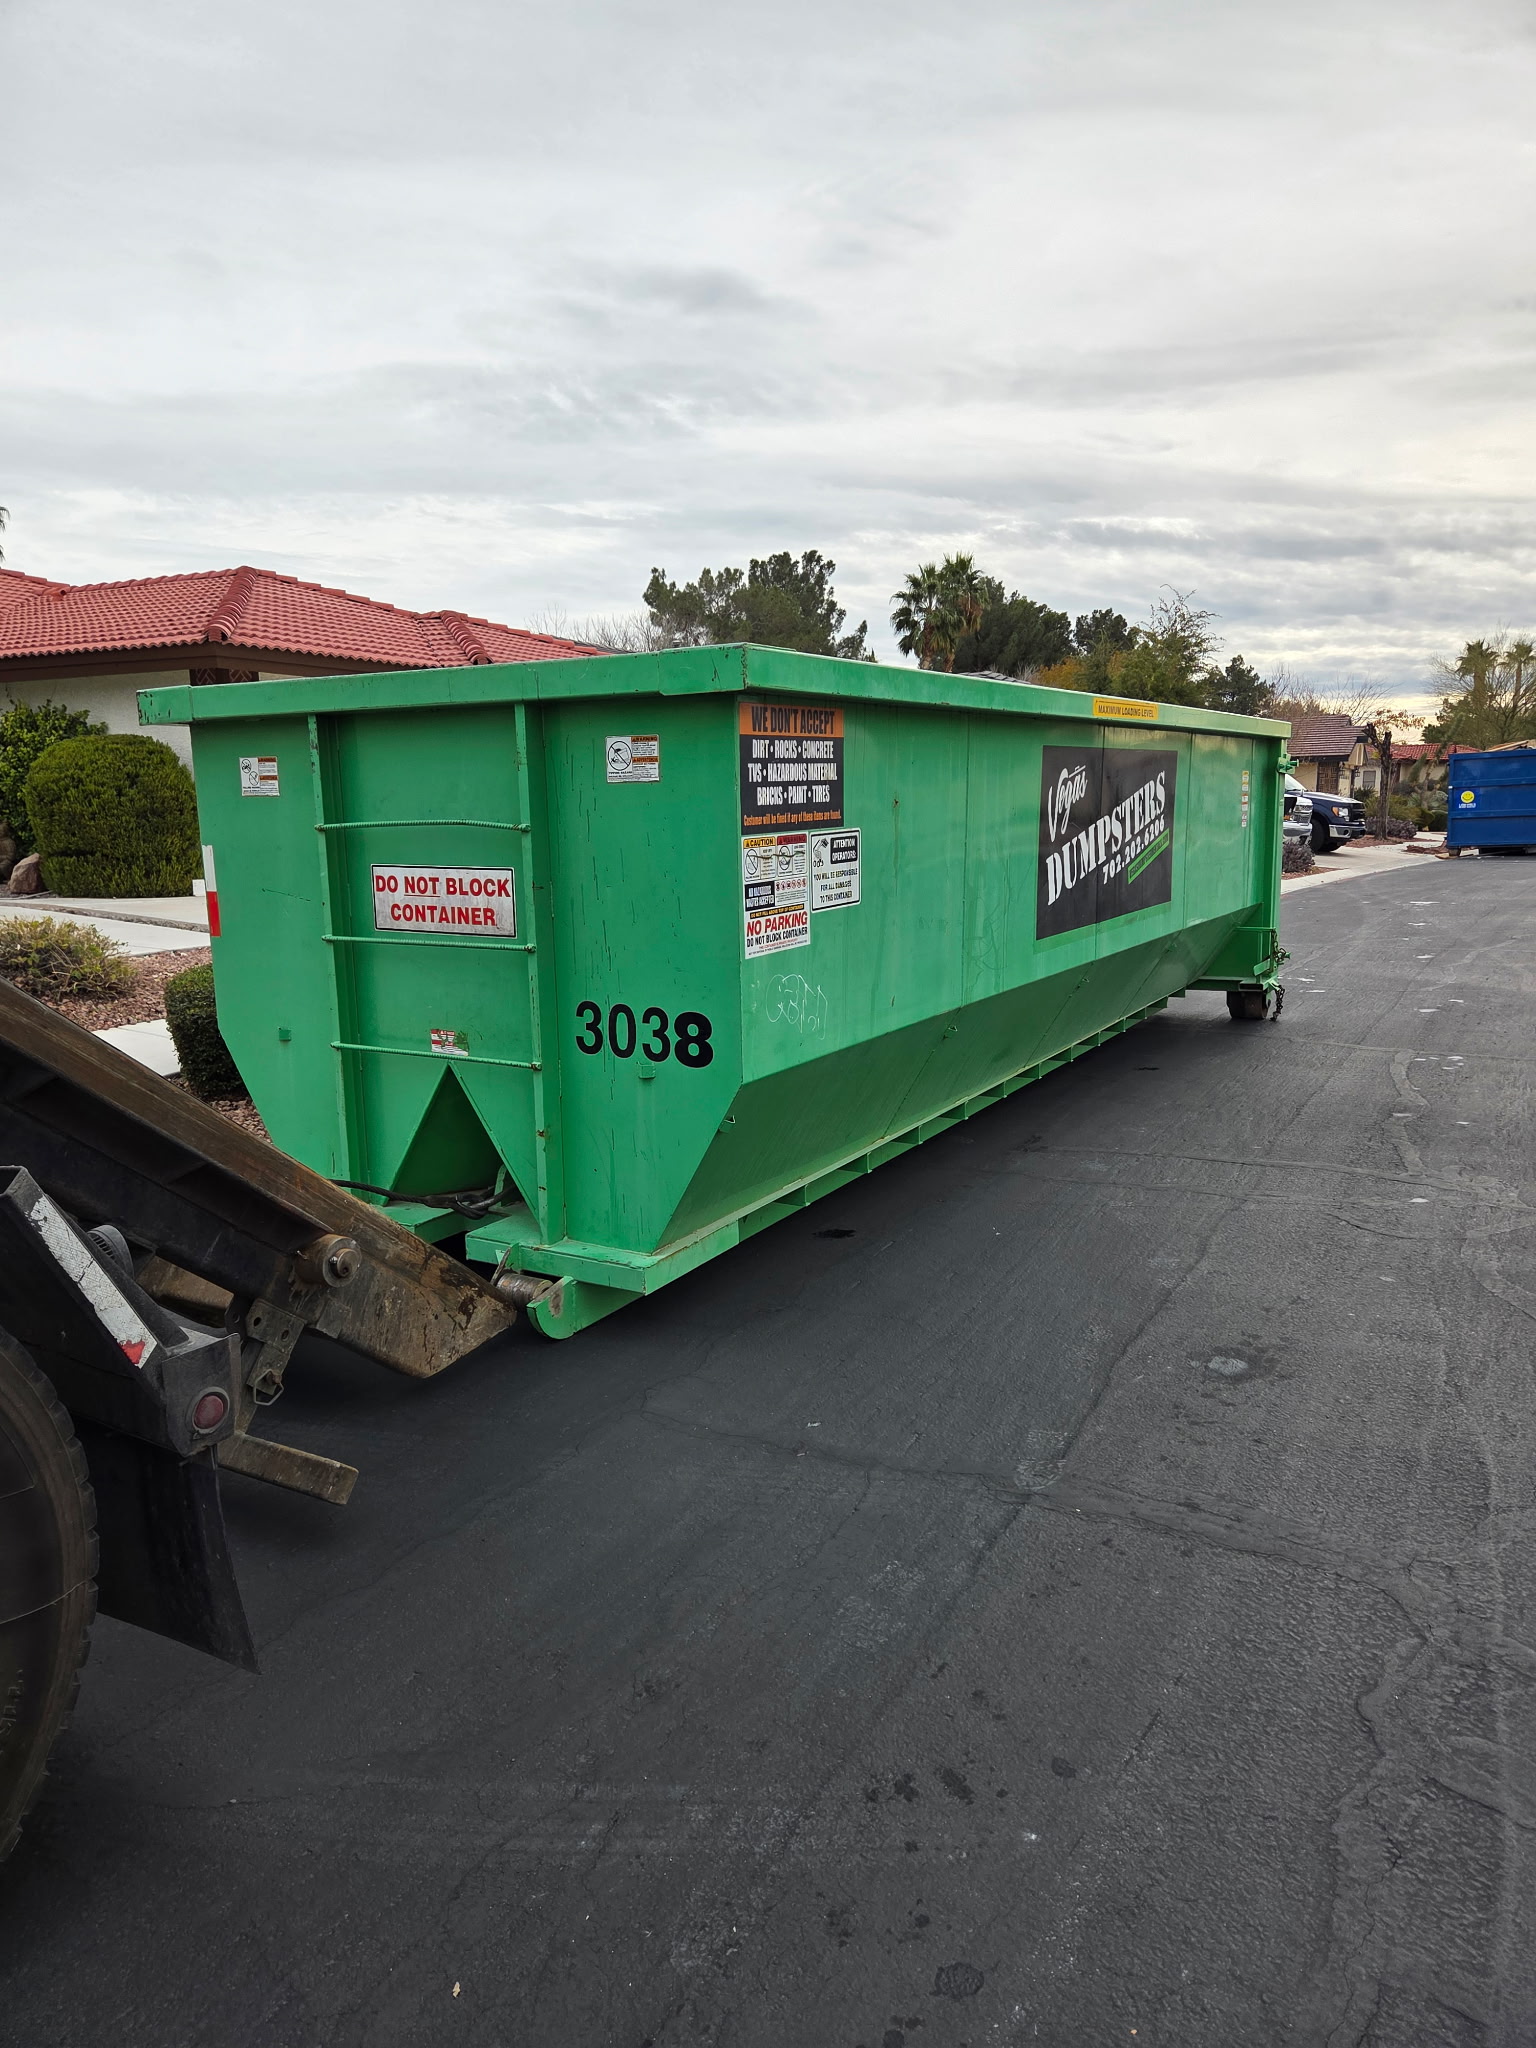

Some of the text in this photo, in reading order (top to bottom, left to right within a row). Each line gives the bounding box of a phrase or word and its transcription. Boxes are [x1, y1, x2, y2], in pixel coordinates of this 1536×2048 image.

[751, 706, 835, 734] WE DON'T ACCEPT
[1122, 707, 1140, 716] LOADING
[1142, 709, 1154, 717] LEVEL
[752, 739, 834, 758] DIRT ROCKS CONCRETE
[748, 763, 837, 782] TVS HAZARDOUS MATERIAL
[757, 785, 830, 805] BRICKS PAINT TIRES
[1048, 765, 1088, 843] Vegas
[744, 814, 762, 826] Customer
[771, 814, 776, 824] be
[750, 838, 773, 846] CAUTION
[833, 839, 855, 848] ATTENTION
[1046, 770, 1166, 905] DUMPSTERS
[832, 850, 856, 861] OPERATORS:
[1103, 814, 1165, 885] 702.202.6206
[836, 868, 857, 877] RESPONSIBLE
[375, 875, 511, 897] DO NOT BLOCK
[820, 891, 852, 903] TO THIS CONTAINER
[391, 903, 496, 926] CONTAINER
[747, 911, 807, 937] NO PARKING
[747, 938, 753, 947] DO
[755, 936, 764, 945] NOT
[766, 932, 781, 943] BLOCK
[783, 927, 807, 939] CONTAINER
[575, 1000, 714, 1068] 3038
